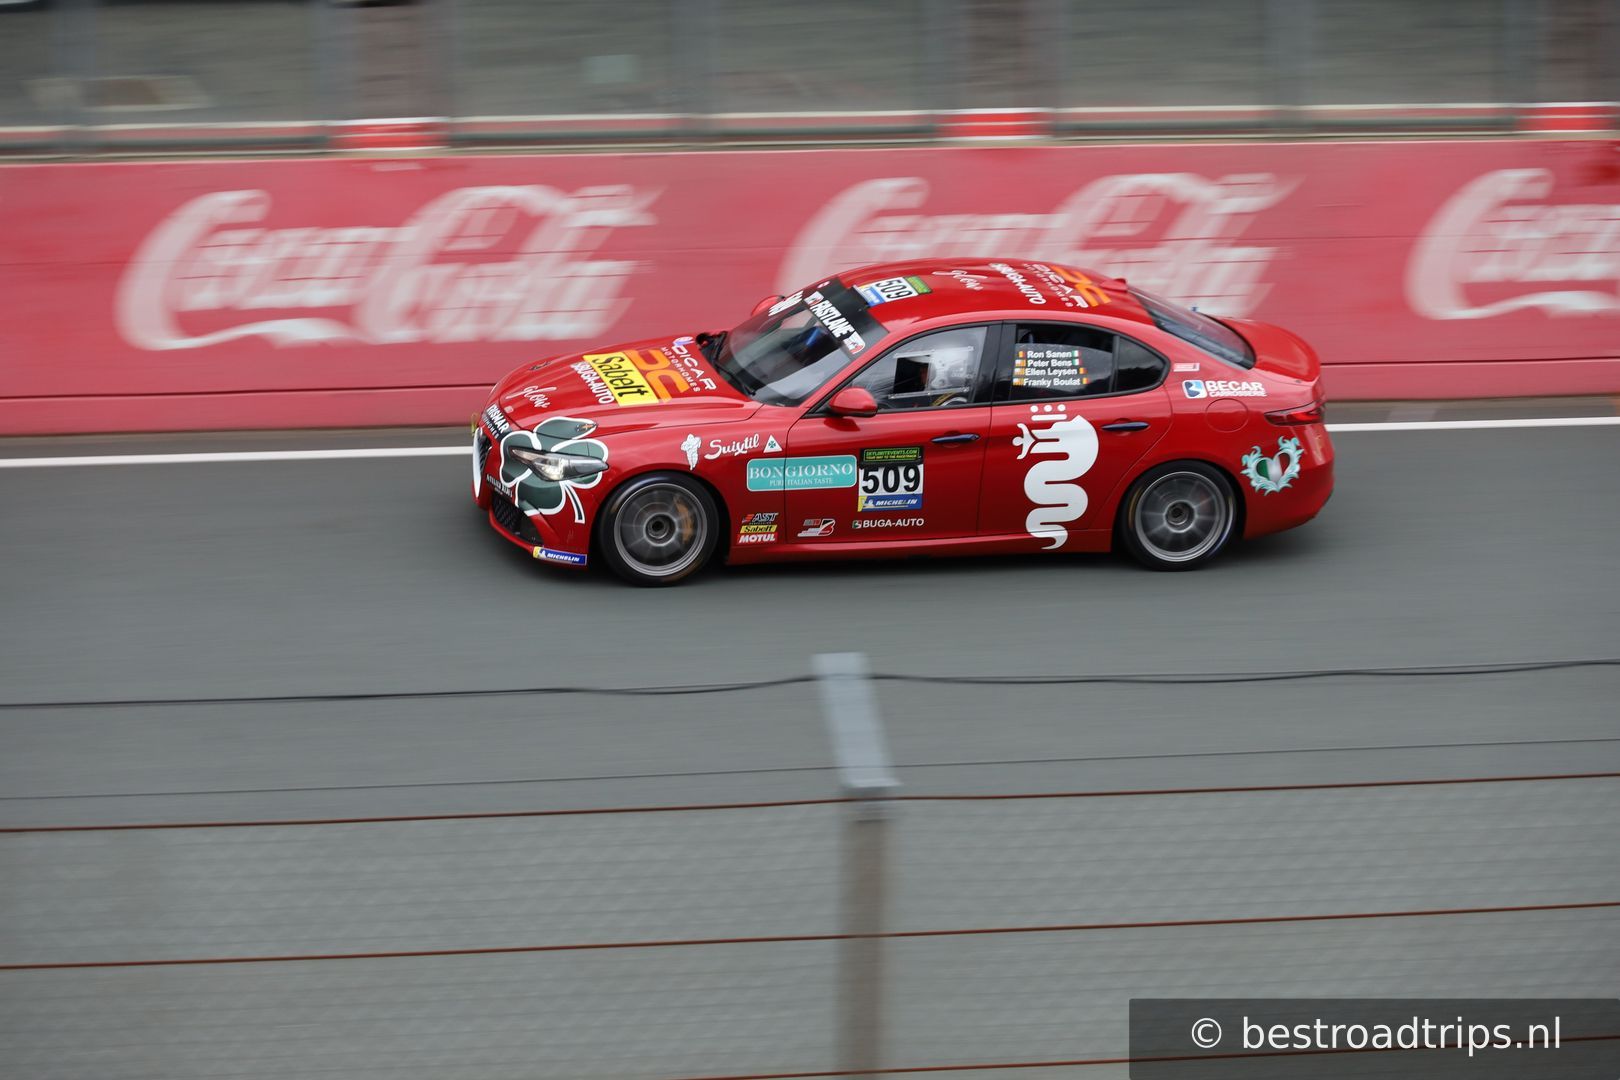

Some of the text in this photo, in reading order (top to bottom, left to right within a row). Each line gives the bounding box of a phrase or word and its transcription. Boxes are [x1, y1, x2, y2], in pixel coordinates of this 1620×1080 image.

[875, 279, 913, 299] 509
[1027, 350, 1072, 358] Ron Sanen
[671, 345, 717, 390] DICAR
[1027, 359, 1072, 367] Peter Bens
[592, 353, 650, 399] Sabelt
[1025, 368, 1077, 377] Ellen Leysen
[1023, 378, 1052, 388] Franky
[1205, 380, 1264, 391] BECAR
[749, 463, 853, 480] BONGIORNO
[787, 478, 813, 486] ITALIAN
[862, 464, 921, 494] 509
[875, 498, 918, 506] MICHELIN
[863, 518, 925, 528] BUGA-AUTO
[739, 533, 776, 544] MOTUL
[547, 552, 580, 563] MICHELIN
